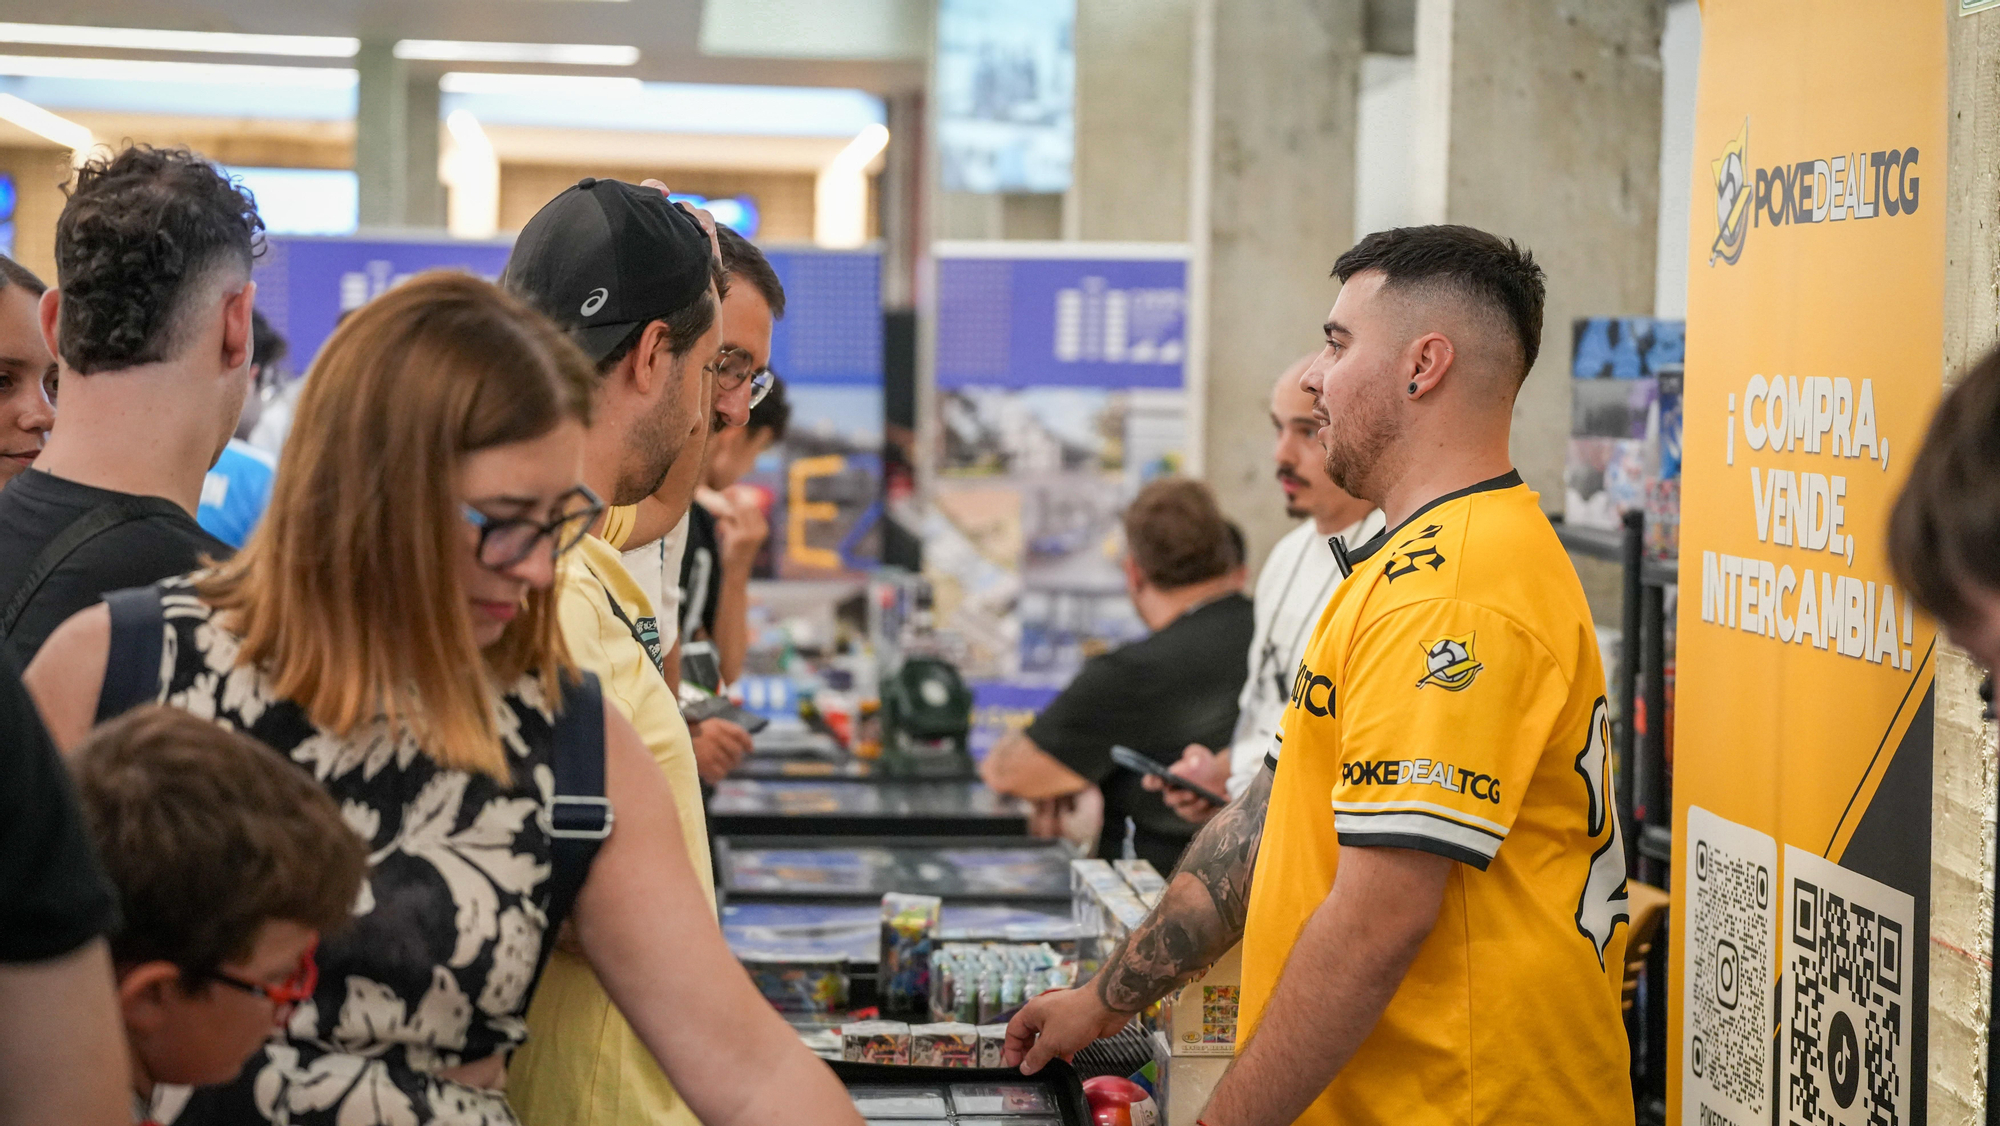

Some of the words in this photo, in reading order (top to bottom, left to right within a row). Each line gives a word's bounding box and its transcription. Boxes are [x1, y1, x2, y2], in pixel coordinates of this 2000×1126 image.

[1754, 147, 1919, 228] POKEDEALTCG
[1751, 466, 1854, 567] VENDE,
[1702, 550, 1913, 671] INTERCAMBIA!
[1342, 759, 1500, 804] POKEDEALTCG
